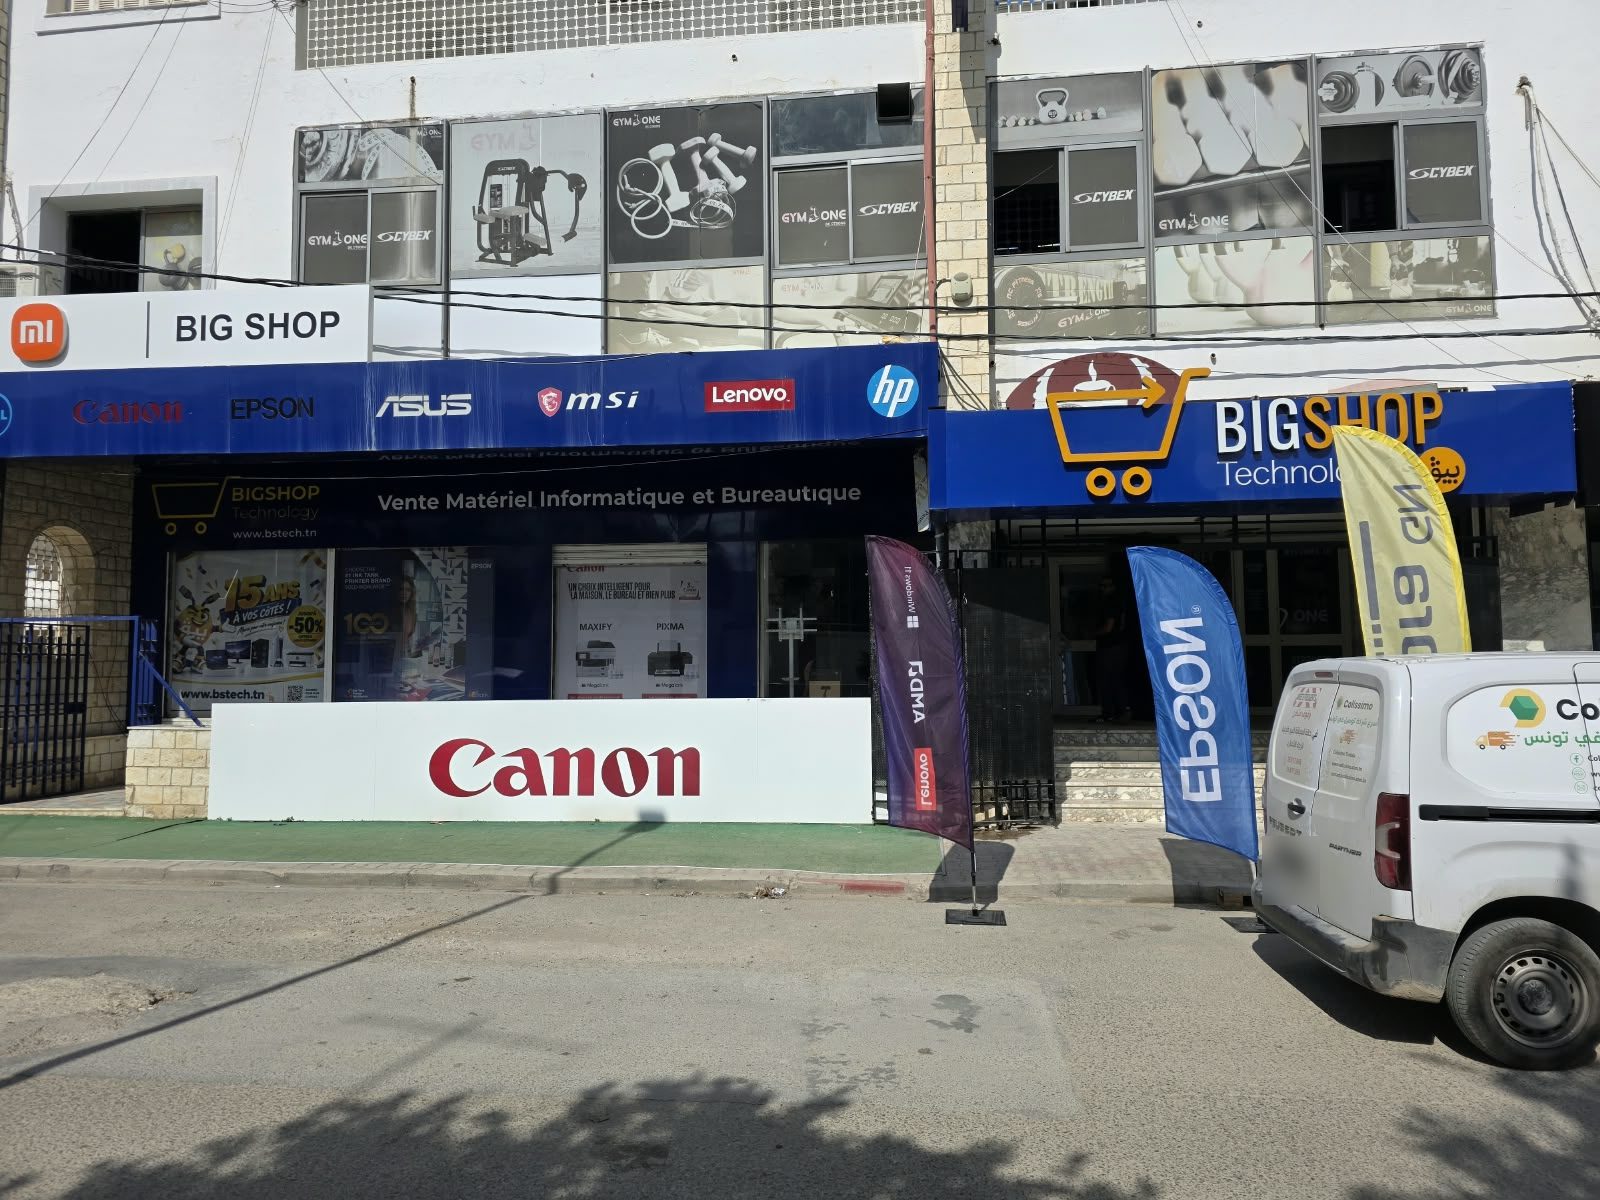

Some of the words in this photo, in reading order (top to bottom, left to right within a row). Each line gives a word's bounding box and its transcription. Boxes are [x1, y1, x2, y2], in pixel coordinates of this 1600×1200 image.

[613, 117, 632, 126] GYM
[641, 115, 661, 124] ONE
[1429, 165, 1475, 179] CYBEX
[1092, 189, 1134, 203] CYBEX
[877, 201, 919, 215] CYBEX
[782, 212, 807, 224] GYM
[821, 209, 847, 221] ONE
[1159, 218, 1186, 230] GYM
[1201, 215, 1229, 226] ONE
[308, 234, 332, 246] GYM
[343, 234, 368, 245] ONE
[392, 229, 432, 242] CYBEX
[1473, 304, 1492, 313] ONE
[176, 314, 233, 342] BIG
[244, 310, 341, 340] SHOP
[1058, 312, 1084, 328] GYM
[712, 386, 788, 403] Lenovo
[872, 364, 914, 418] hp
[375, 393, 472, 418] ASUS
[565, 390, 640, 410] msi
[73, 399, 183, 424] Canon
[230, 396, 314, 420] EPSON
[1216, 458, 1342, 486] Technol
[231, 485, 321, 502] BIGSHOP
[378, 494, 440, 511] Vente
[447, 490, 533, 509] Matériel
[540, 487, 685, 509] Informatique
[692, 488, 715, 504] et
[722, 485, 862, 506] Bureautique
[231, 505, 320, 521] Technology
[232, 528, 317, 539] www.bstech.tn
[223, 574, 267, 613] 15
[263, 580, 301, 601] ANS
[568, 583, 577, 591] UN
[597, 582, 634, 591] INTELLIGENT
[634, 582, 651, 591] POUR
[570, 591, 578, 600] LA
[606, 591, 613, 600] LE
[613, 591, 637, 600] BUREAU
[638, 591, 645, 600] ET
[645, 590, 660, 600] BIEN
[660, 590, 676, 600] PLUS
[242, 609, 258, 622] VOS
[579, 623, 613, 632] MAXIFY
[656, 622, 685, 631] PIXMA
[180, 689, 265, 700] www.bstech.tn
[1343, 699, 1374, 711] Colissimo
[1524, 731, 1569, 748] تونس
[429, 738, 700, 797] Canon
